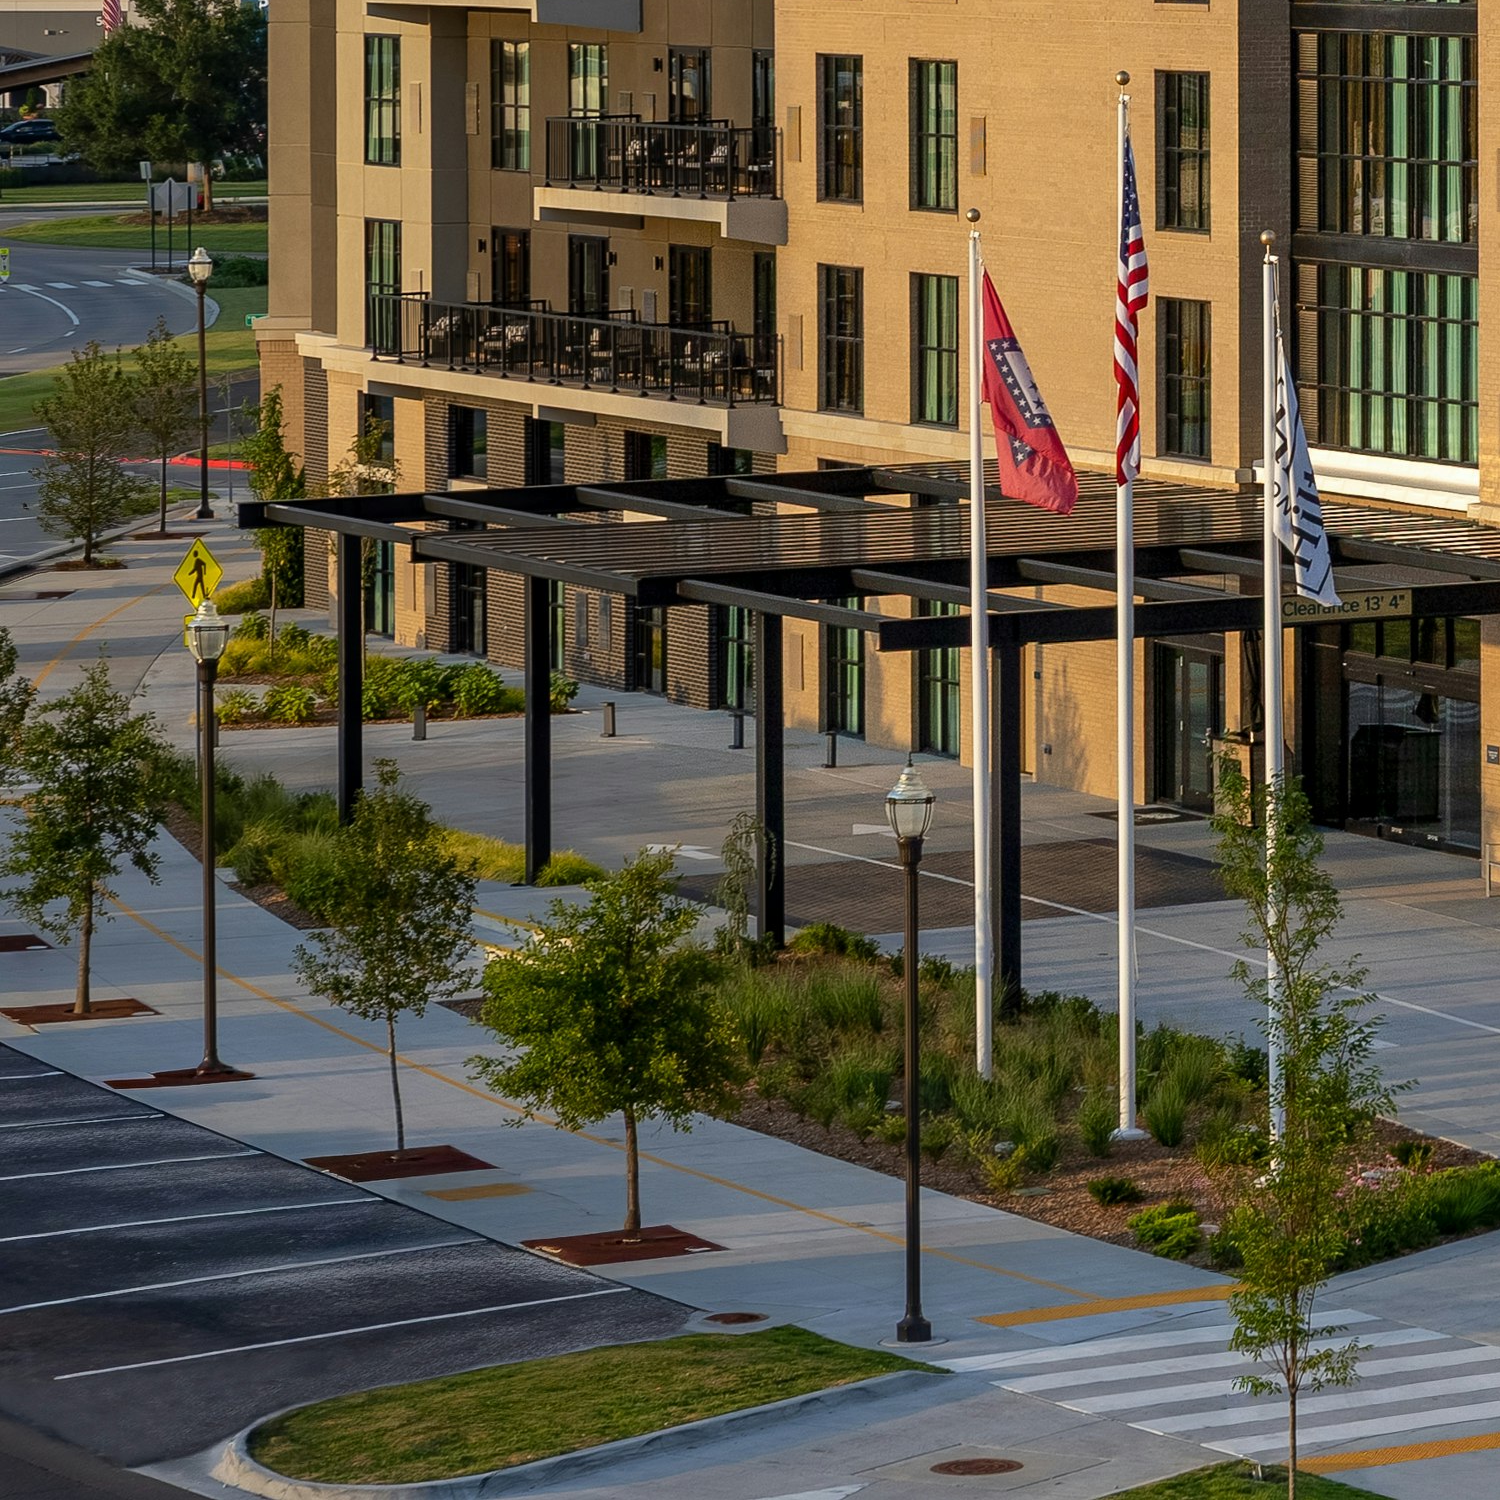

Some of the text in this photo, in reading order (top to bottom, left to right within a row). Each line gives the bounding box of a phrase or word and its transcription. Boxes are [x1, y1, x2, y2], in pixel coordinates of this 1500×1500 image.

[1282, 595, 1405, 617] Clearance 13' 4"
